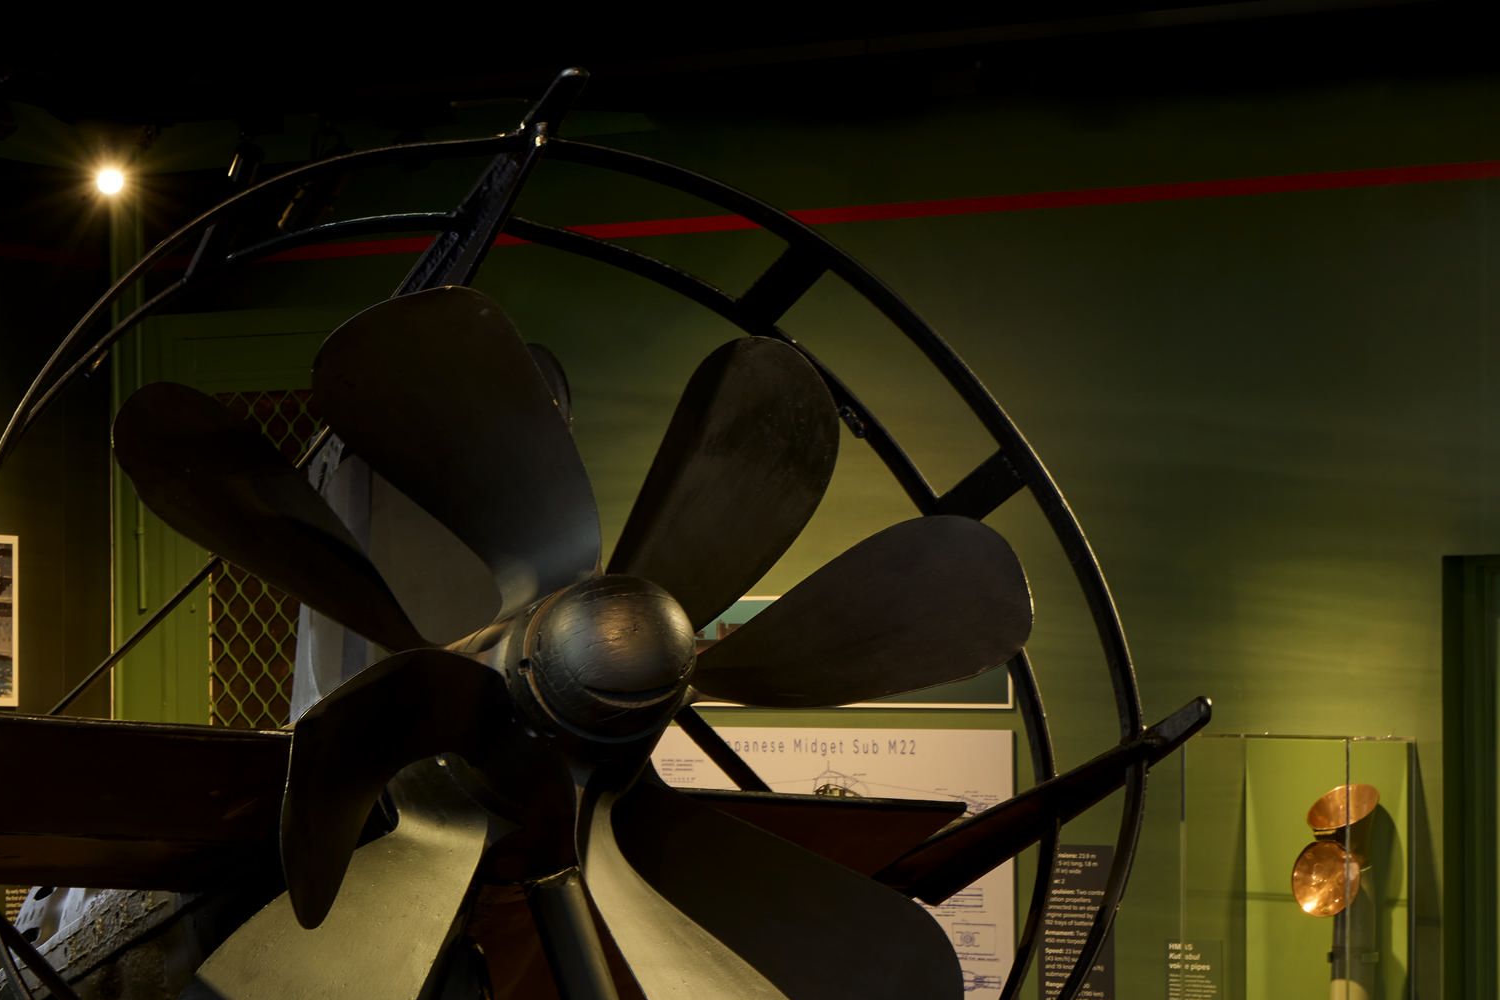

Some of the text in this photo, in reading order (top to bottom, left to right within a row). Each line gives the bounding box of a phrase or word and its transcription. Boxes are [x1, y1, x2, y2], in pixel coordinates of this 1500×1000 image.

[794, 738, 844, 756] Midget
[853, 739, 879, 754] Sub
[888, 740, 917, 755] M22
